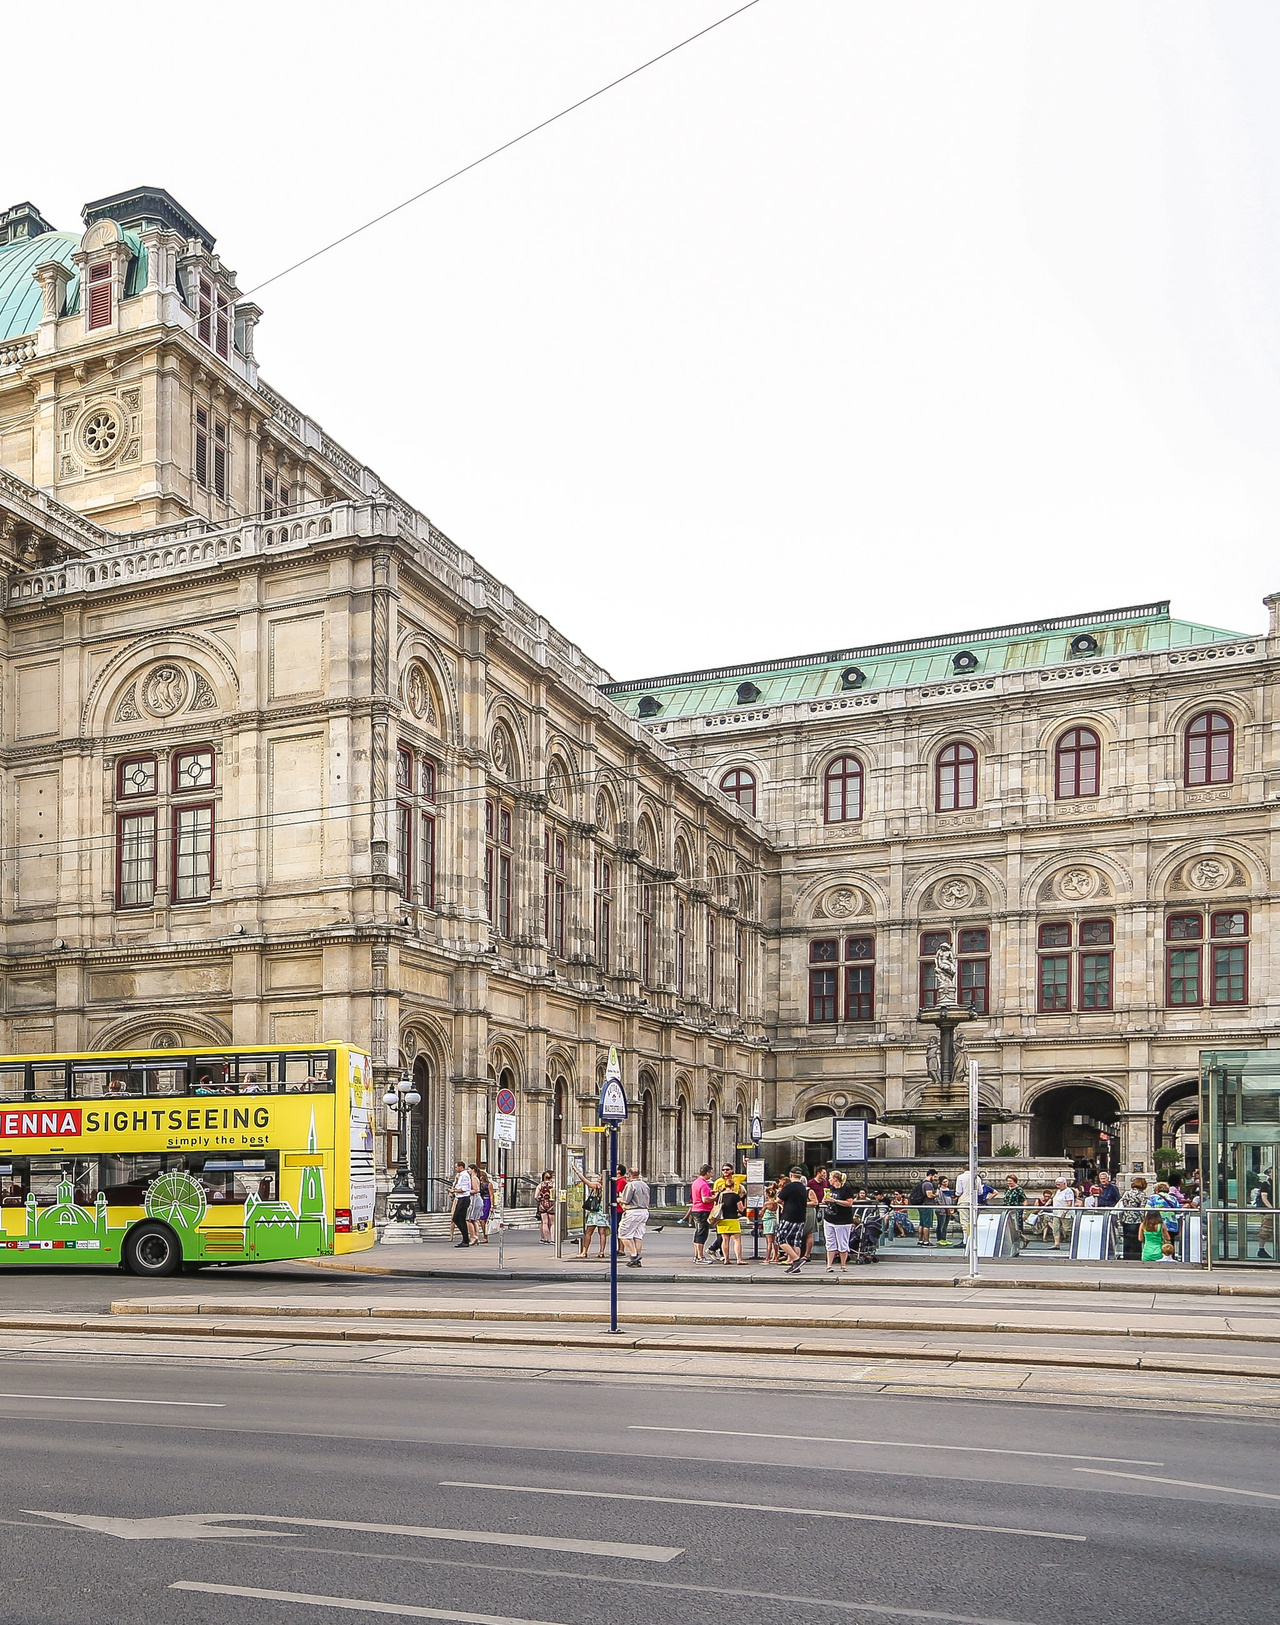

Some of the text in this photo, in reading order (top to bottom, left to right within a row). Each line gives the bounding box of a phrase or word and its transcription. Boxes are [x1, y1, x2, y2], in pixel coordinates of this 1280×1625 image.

[86, 1107, 270, 1132] SIGHTSEEING
[167, 1134, 270, 1146] simply the best
